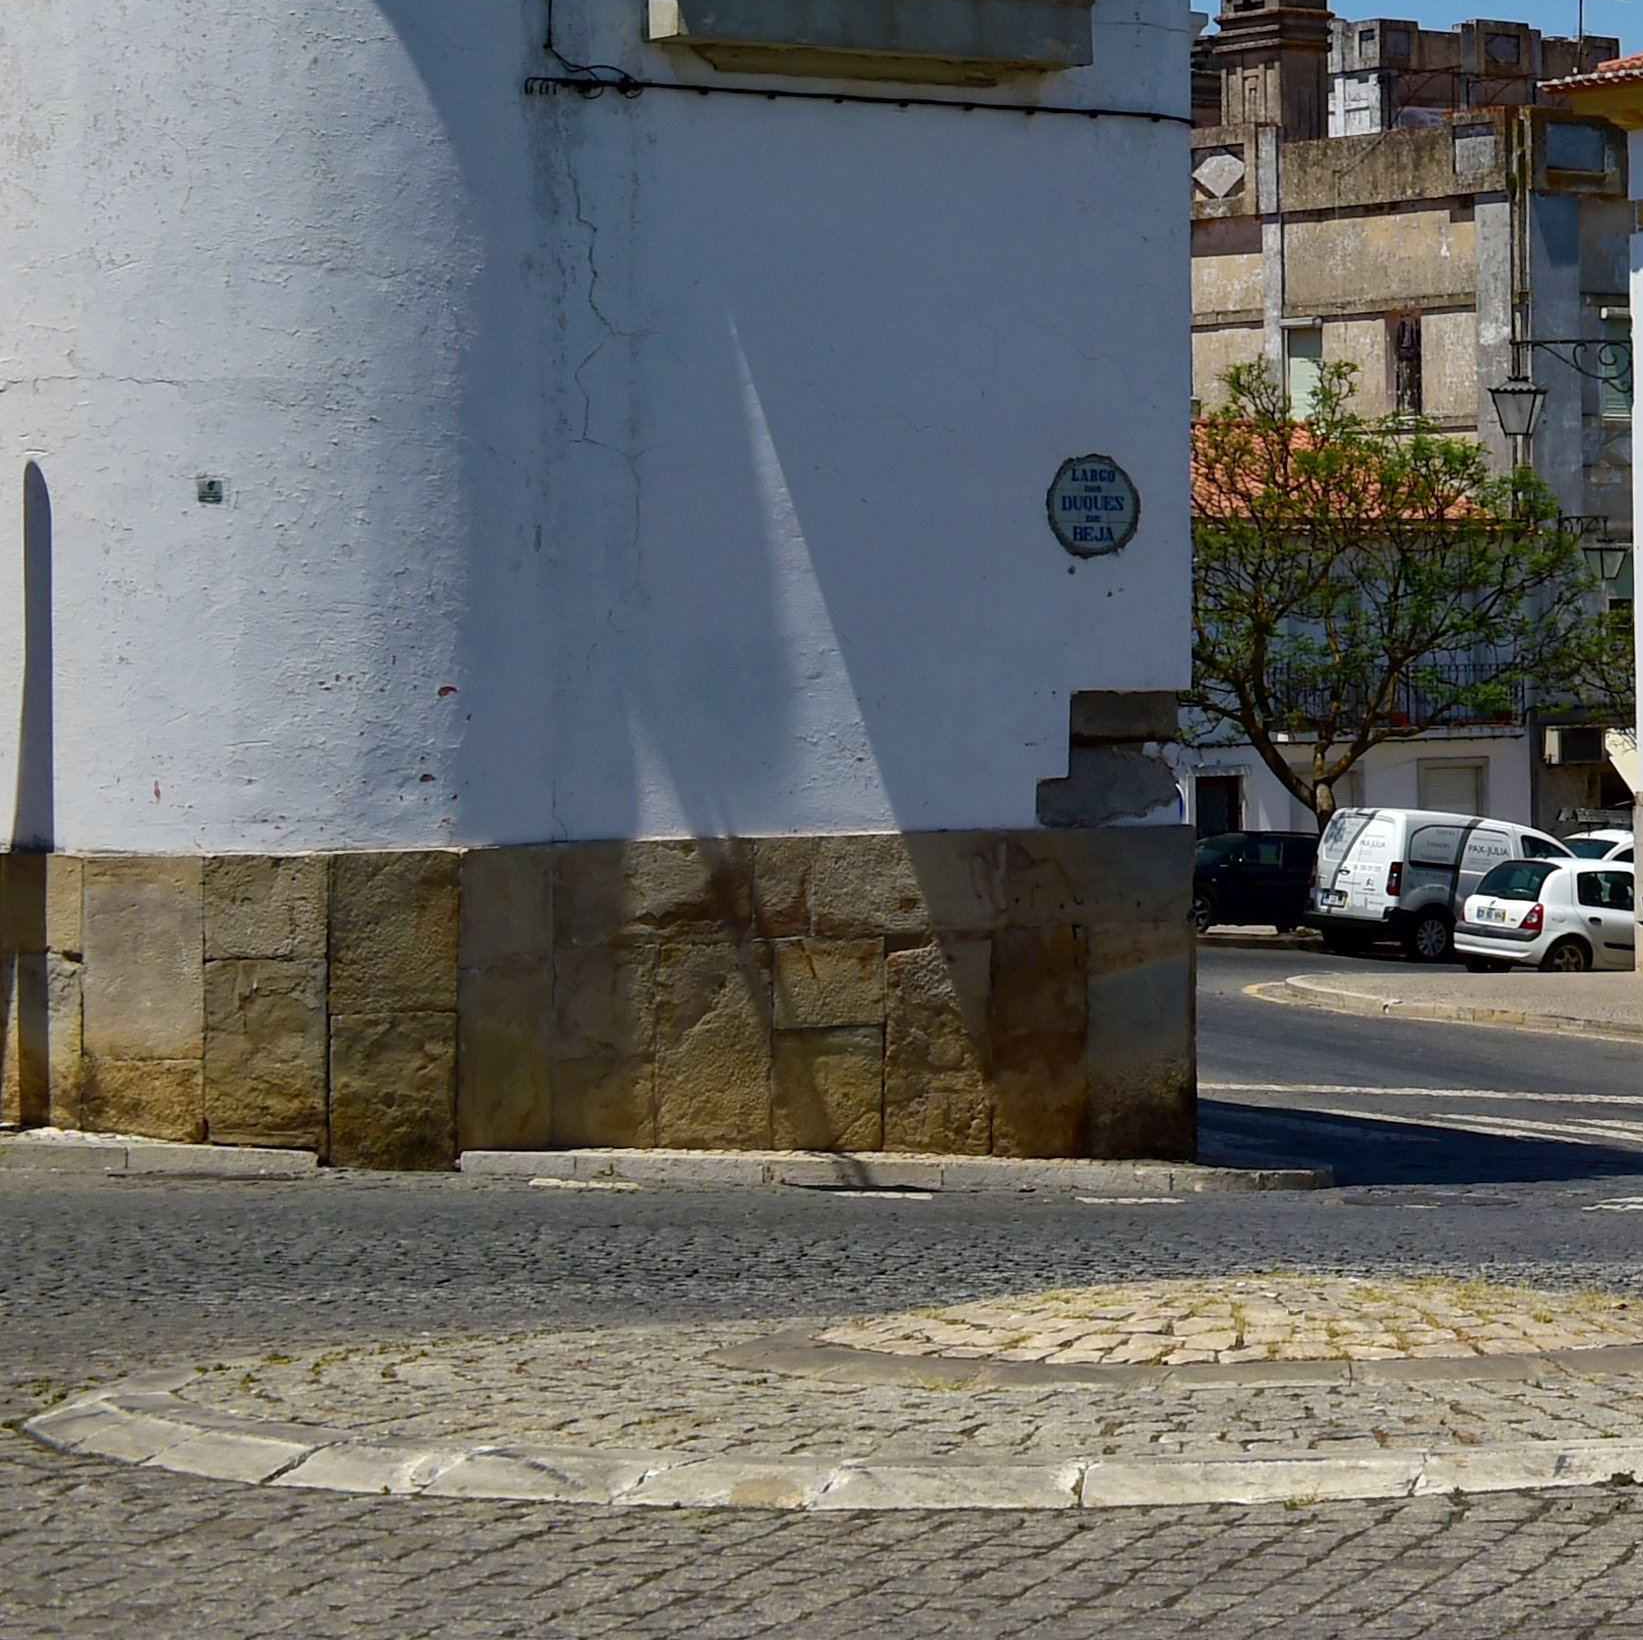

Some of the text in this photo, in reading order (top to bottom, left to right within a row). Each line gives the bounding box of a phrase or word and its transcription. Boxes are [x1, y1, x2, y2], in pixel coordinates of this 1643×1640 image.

[1071, 468, 1116, 483] LARGO
[1062, 495, 1125, 511] DUQUES
[1086, 515, 1101, 523] DE
[1073, 526, 1115, 542] BEJA
